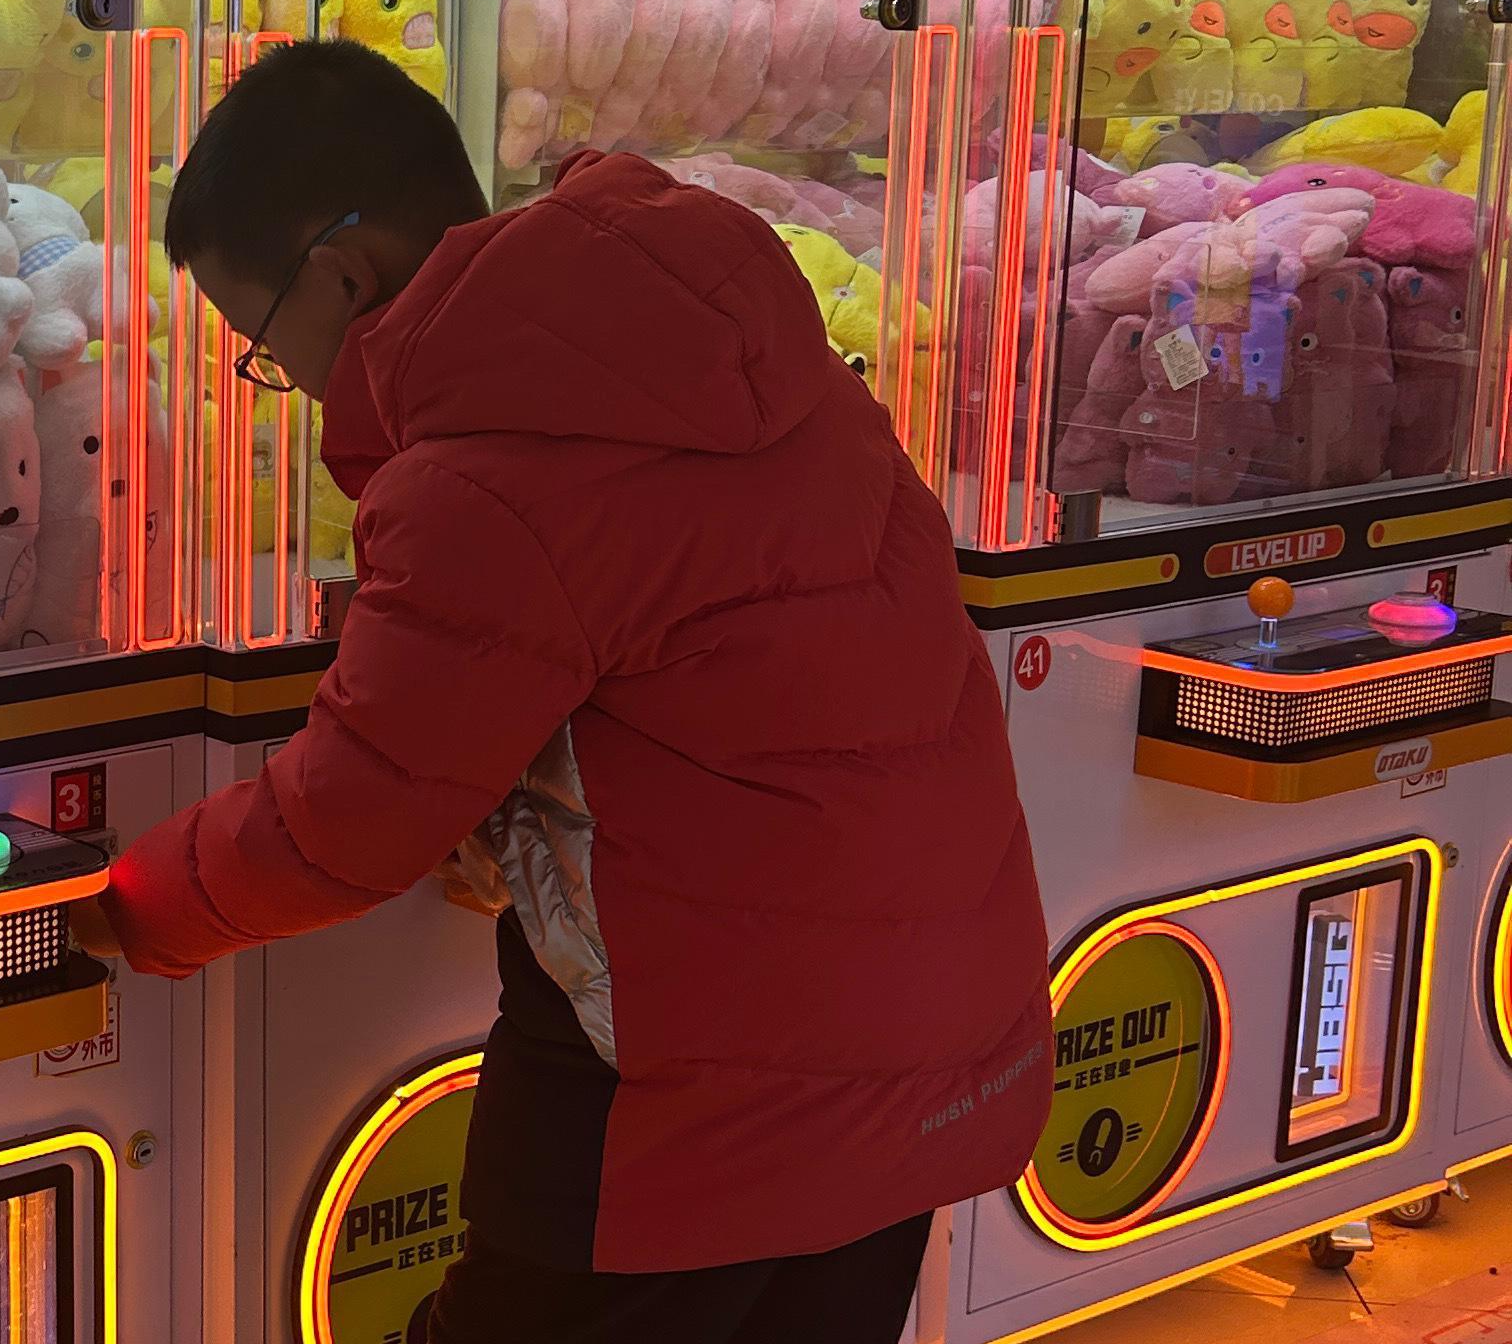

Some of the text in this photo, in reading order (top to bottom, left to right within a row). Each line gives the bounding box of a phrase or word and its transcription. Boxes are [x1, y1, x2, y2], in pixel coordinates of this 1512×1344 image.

[1232, 536, 1294, 572] LEVEL
[1018, 644, 1044, 681] 41
[58, 783, 81, 823] 3
[1055, 1001, 1172, 1069] RIZE OUT
[1074, 1058, 1131, 1091] 正在营业
[346, 1183, 449, 1254] PRIZE
